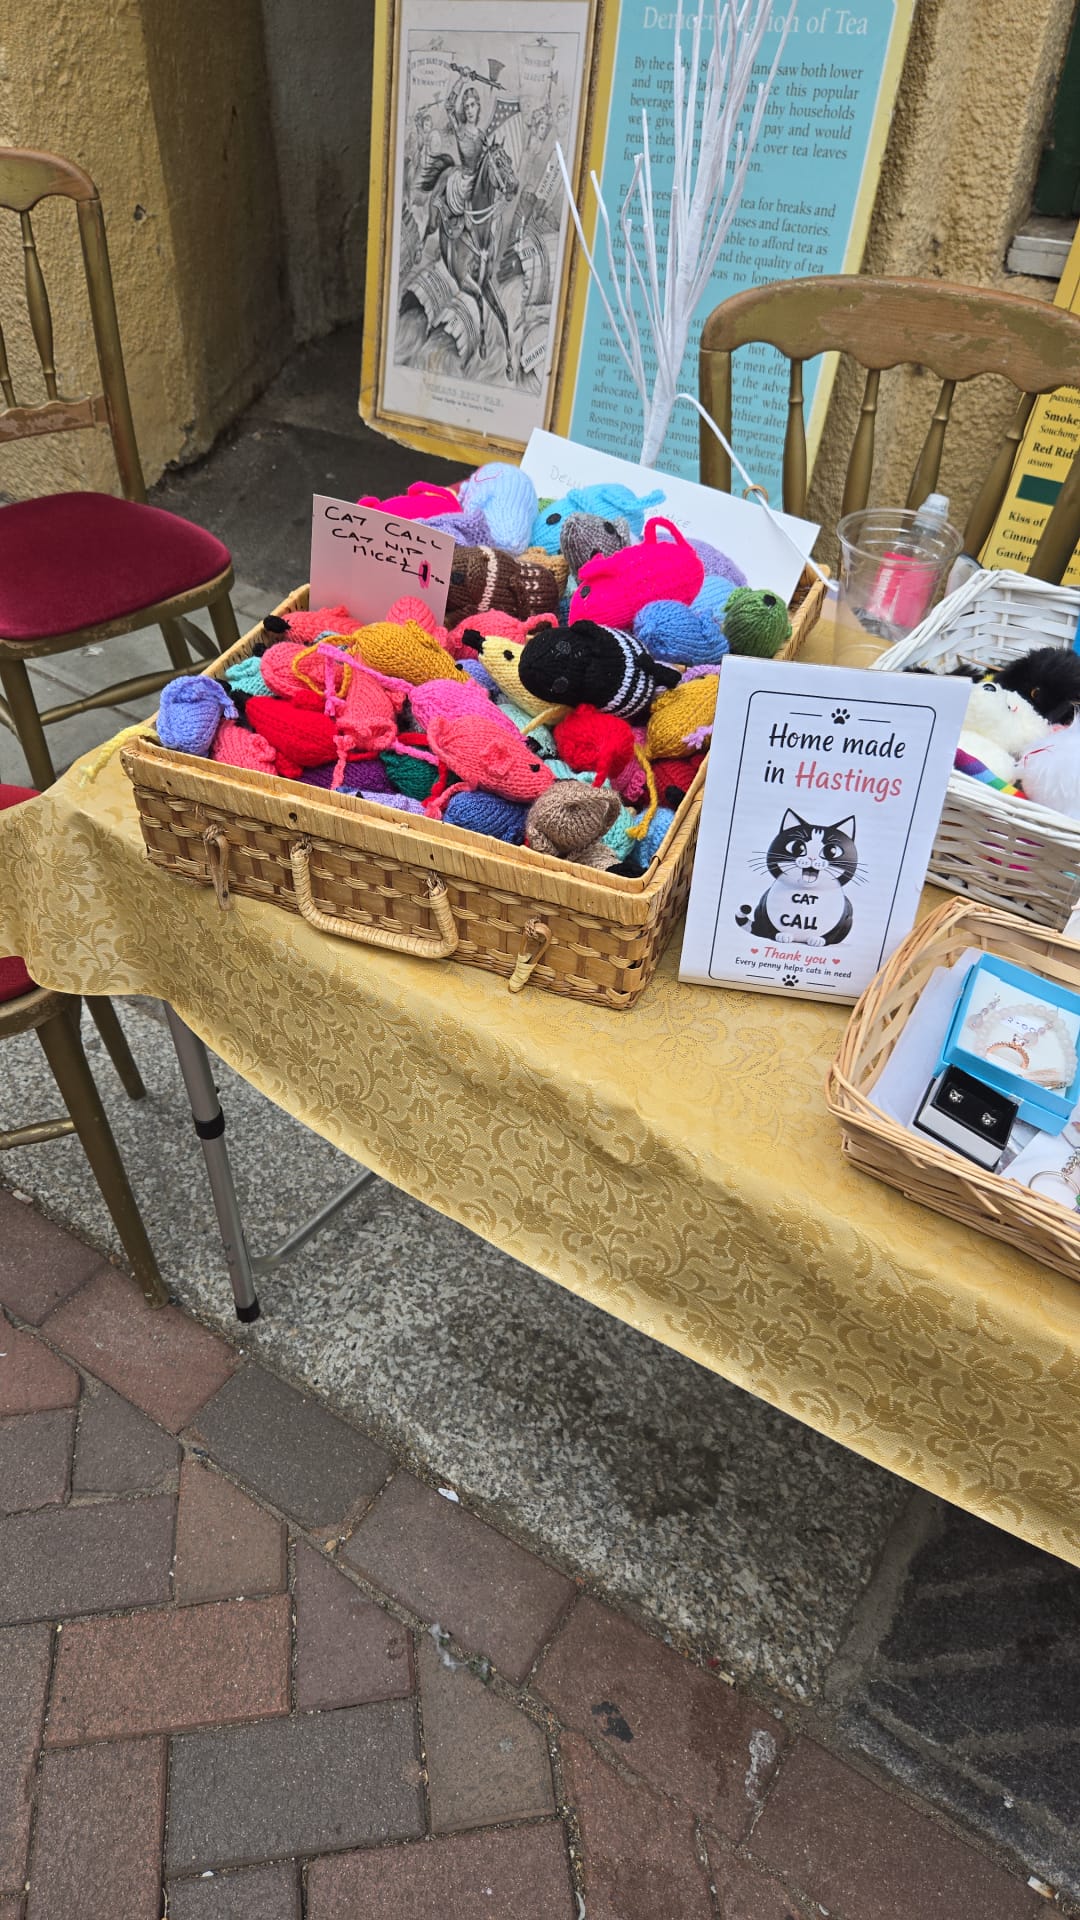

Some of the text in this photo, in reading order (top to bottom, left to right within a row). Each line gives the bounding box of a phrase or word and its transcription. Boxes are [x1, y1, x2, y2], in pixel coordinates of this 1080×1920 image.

[807, 8, 831, 34] of
[835, 10, 868, 35] Tea
[635, 56, 645, 73] By
[649, 56, 665, 70] the
[776, 64, 798, 77] saw
[801, 62, 827, 78] both
[830, 64, 864, 80] lower
[632, 75, 651, 88] and
[786, 82, 807, 97] this
[813, 84, 860, 102] popular
[789, 102, 856, 120] households
[763, 124, 784, 139] pay
[788, 123, 810, 137] and
[815, 125, 852, 140] would
[763, 144, 788, 155] over
[792, 144, 808, 157] tea
[812, 144, 847, 160] leaves
[740, 197, 756, 209] tea
[758, 196, 774, 212] for
[776, 198, 812, 216] breaks
[814, 203, 837, 218] and
[758, 217, 780, 232] and
[781, 219, 831, 237] factories.
[748, 236, 760, 247] to
[762, 235, 795, 252] afford
[797, 242, 813, 254] tea
[816, 245, 828, 256] as
[735, 251, 752, 265] the
[754, 255, 792, 273] quality
[794, 257, 807, 272] of
[808, 261, 824, 274] tea
[733, 271, 747, 282] no
[595, 365, 606, 378] of
[742, 376, 758, 390] the
[744, 362, 766, 374] men
[592, 381, 639, 400] advocated
[591, 398, 618, 412] native
[623, 403, 633, 415] to
[589, 411, 619, 428] Rooms
[1039, 424, 1079, 443] Souchong
[586, 428, 627, 446] reformed
[745, 445, 778, 461] where
[1032, 442, 1054, 456] Red
[748, 461, 780, 477] whilst
[1027, 457, 1053, 470] assam
[324, 506, 443, 550] CAT CALL
[1009, 511, 1046, 528] Kiss of
[332, 528, 373, 543] CAT
[353, 545, 398, 564] MICE
[768, 722, 906, 760] Home made
[764, 760, 903, 803] in Hastings
[791, 893, 819, 906] CAT
[780, 913, 819, 931] CALL
[764, 945, 828, 967] Thank you
[735, 956, 852, 979] Every penny helps cats in need
